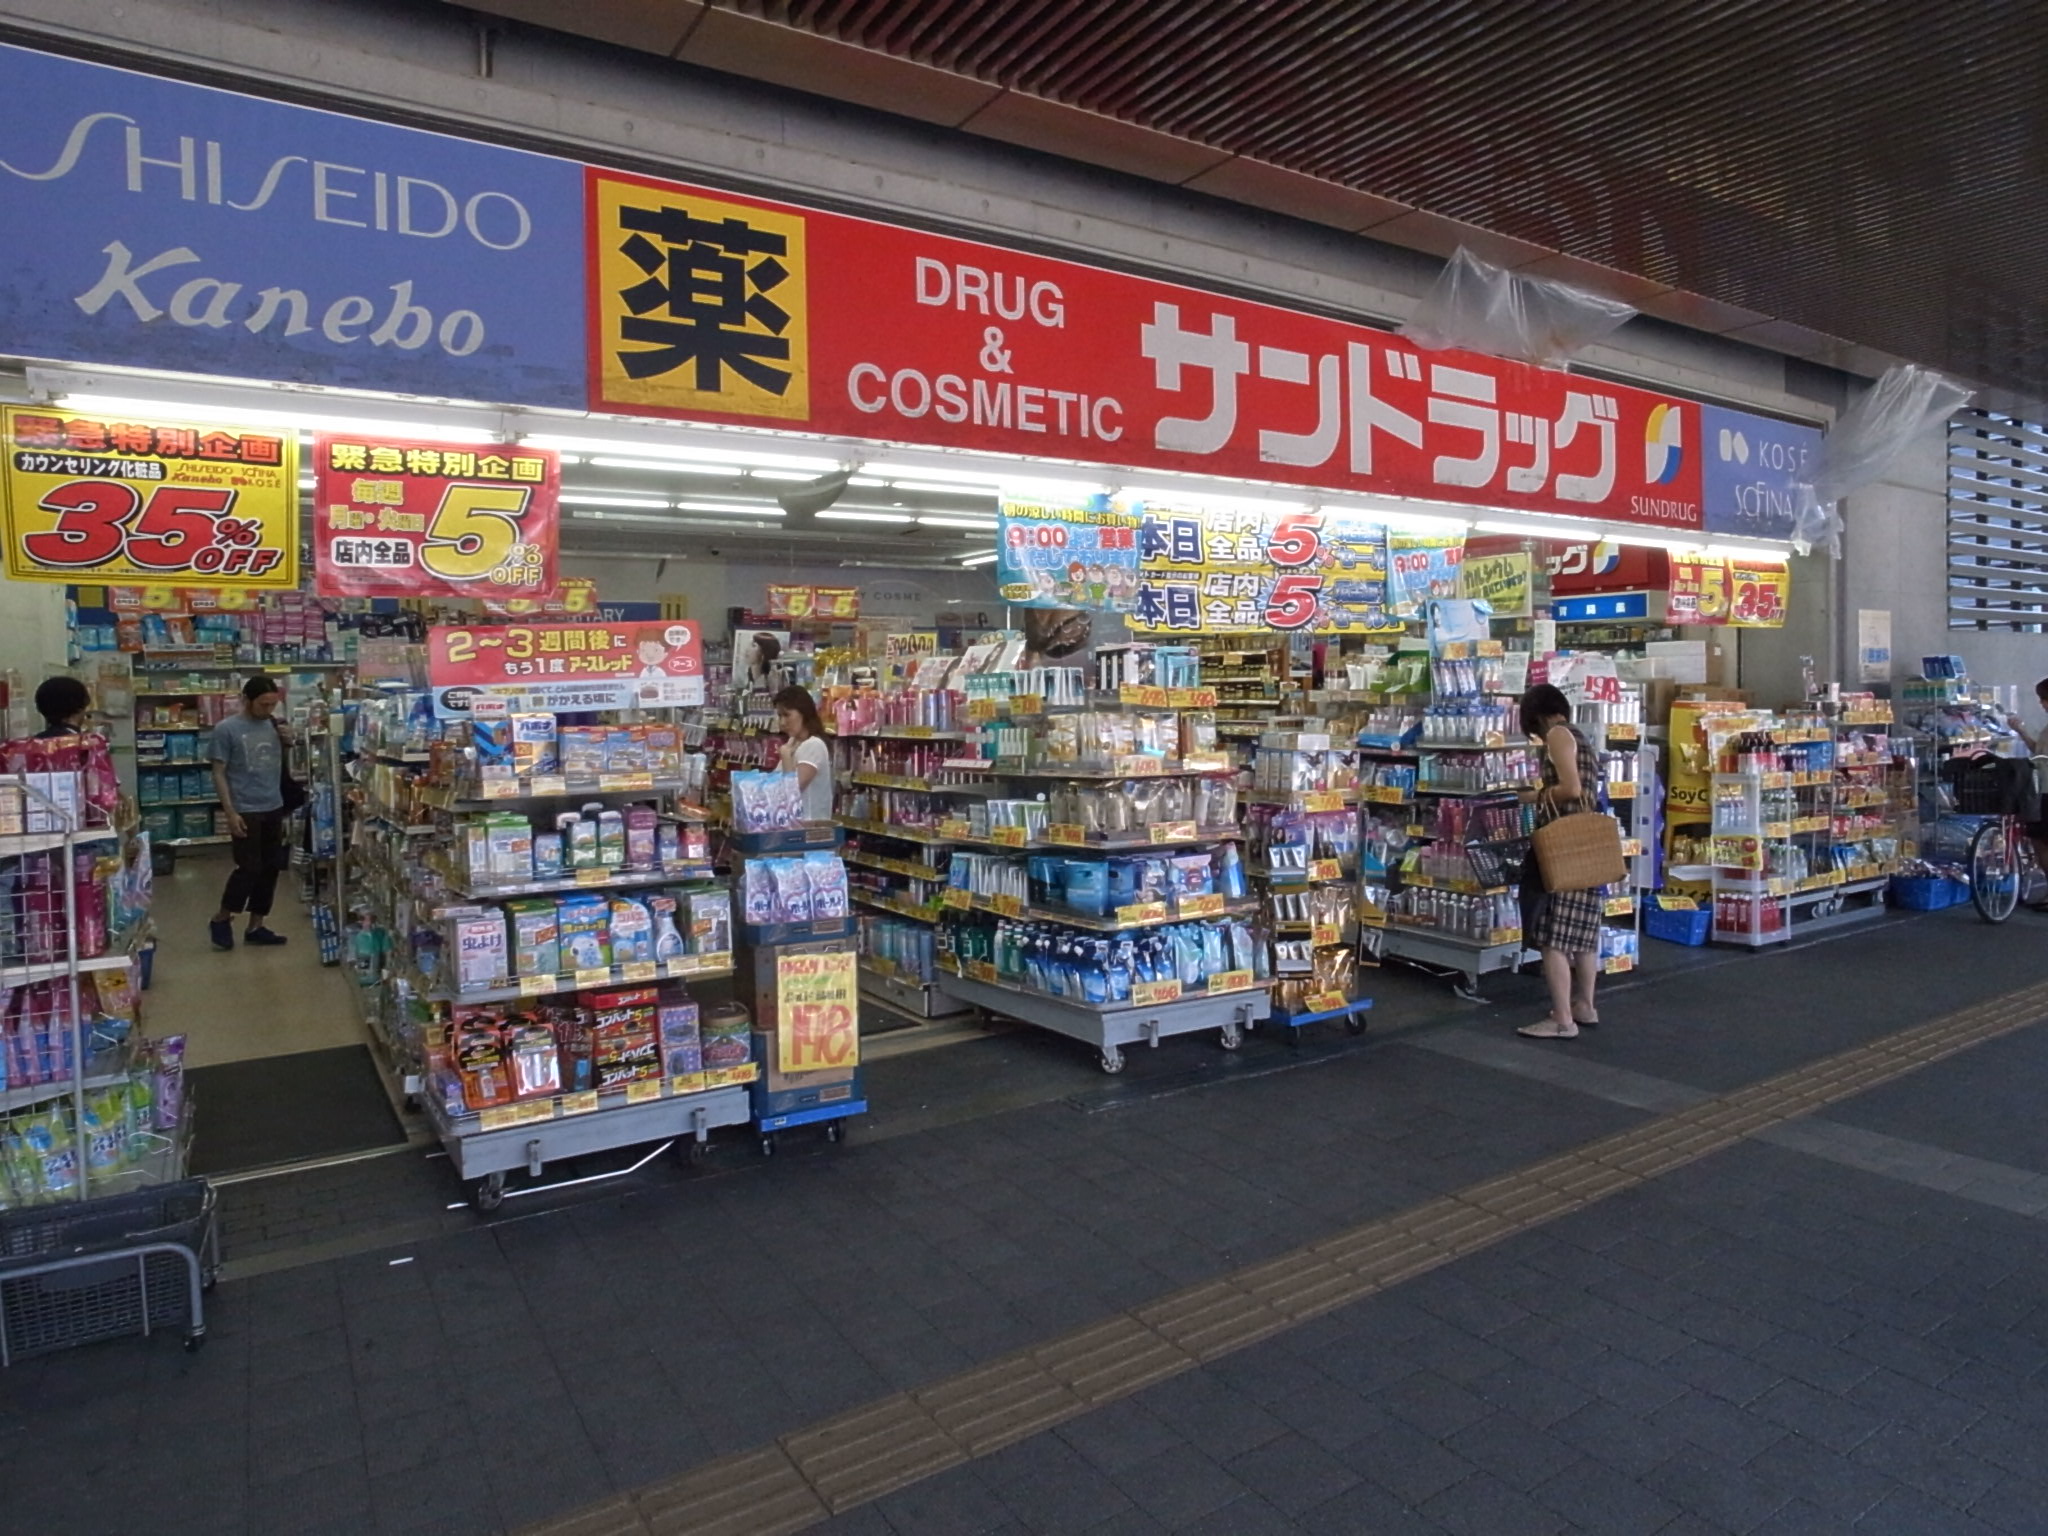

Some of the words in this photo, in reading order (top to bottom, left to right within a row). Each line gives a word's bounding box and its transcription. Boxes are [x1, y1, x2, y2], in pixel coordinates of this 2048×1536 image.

[0, 112, 532, 250] SHISEIDO
[74, 240, 485, 357] Kanebo
[617, 205, 791, 396] 薬
[915, 256, 1065, 328] DRUG
[979, 326, 1013, 374] &
[848, 362, 1123, 441] COSMETIC
[1141, 301, 1619, 503] サンドラッグ
[14, 414, 283, 466] 緊急特別企画
[21, 453, 164, 480] カウンセリング化粧品
[331, 443, 546, 482] 緊急特別企画
[1631, 496, 1697, 522] SUNDRUG
[1735, 481, 1794, 523] SOFINA
[335, 541, 411, 565] 店内全品
[1141, 515, 1204, 564] 本日
[1206, 536, 1263, 561] 全品
[195, 548, 282, 575] OFF
[490, 566, 542, 586] OFF
[1464, 557, 1514, 590] カルシウム
[1137, 584, 1200, 628] 本日
[1202, 573, 1259, 597] 店内
[1204, 600, 1260, 624] 全品
